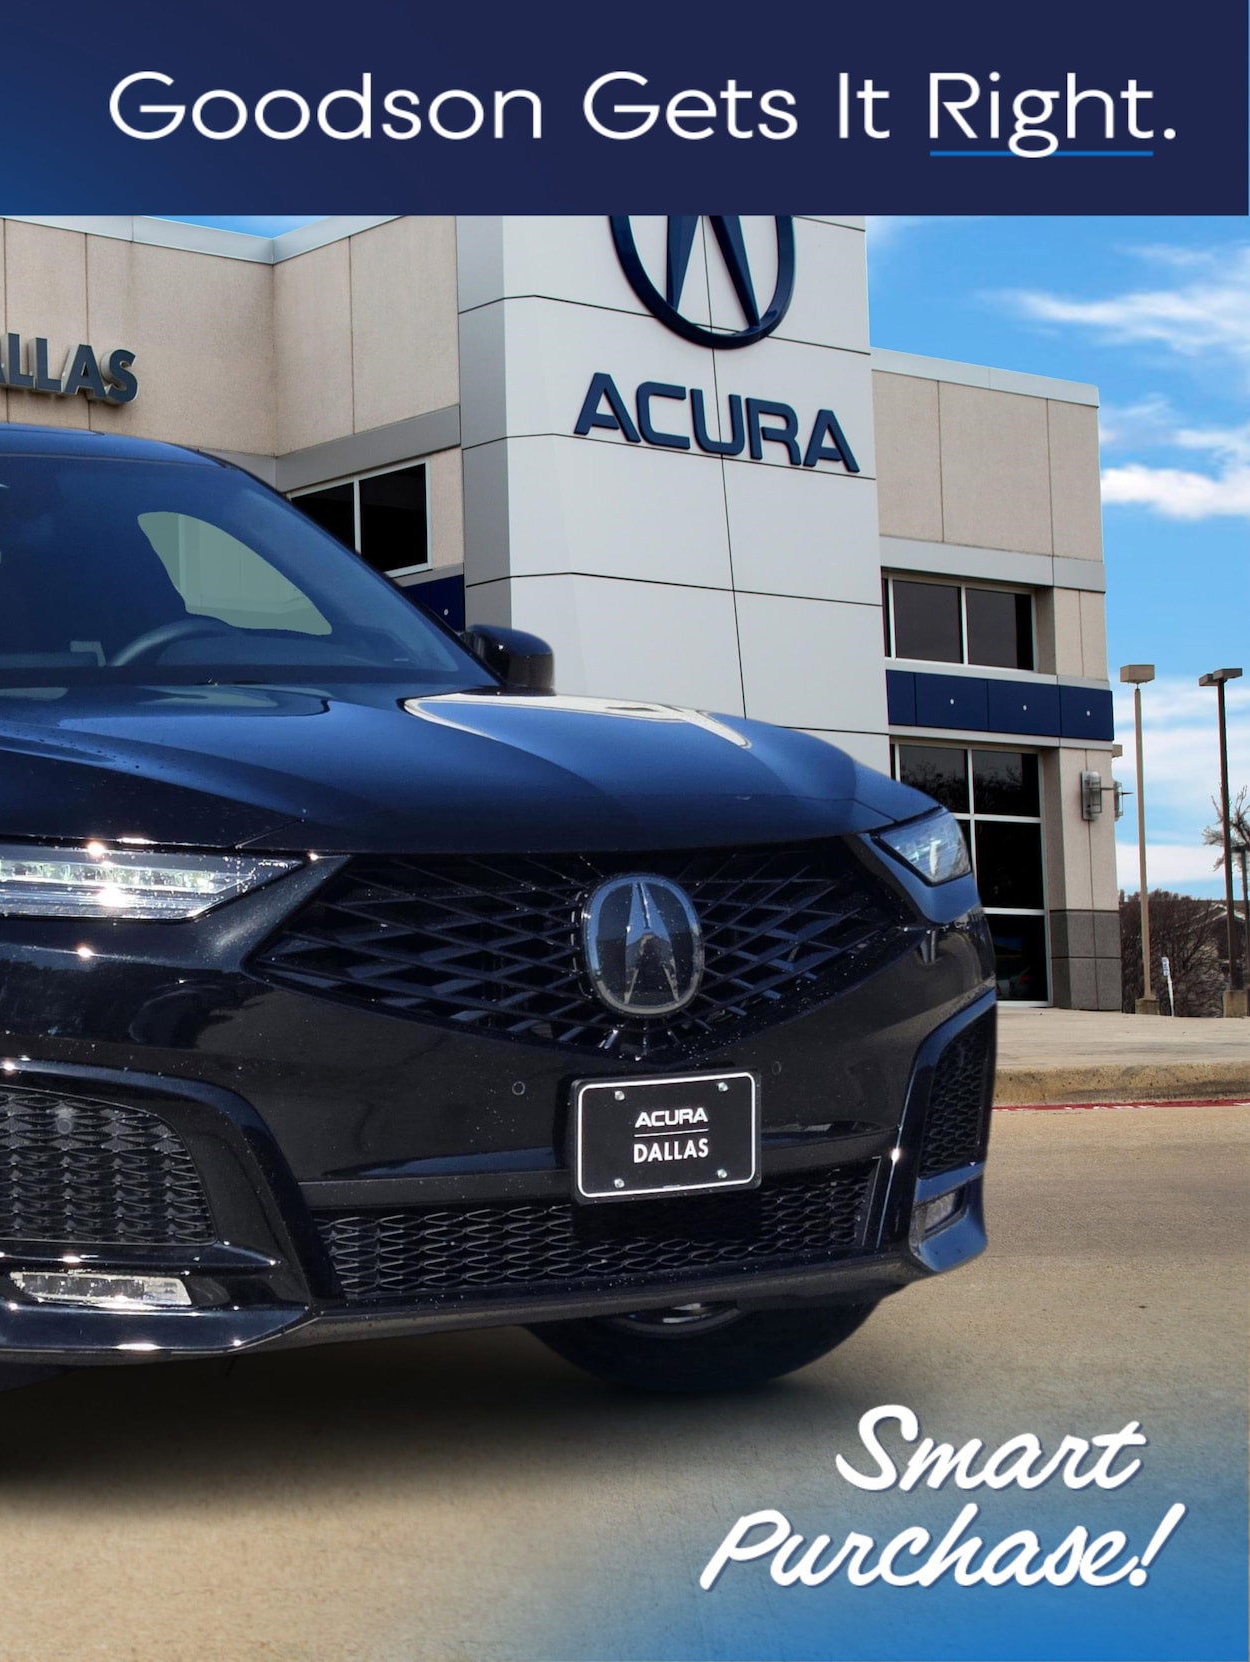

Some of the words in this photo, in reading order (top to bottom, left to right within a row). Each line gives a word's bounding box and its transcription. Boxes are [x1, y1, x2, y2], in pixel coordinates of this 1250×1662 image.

[573, 372, 860, 473] ACURA
[634, 1107, 708, 1128] ACURA
[633, 1137, 709, 1163] DALLAS
